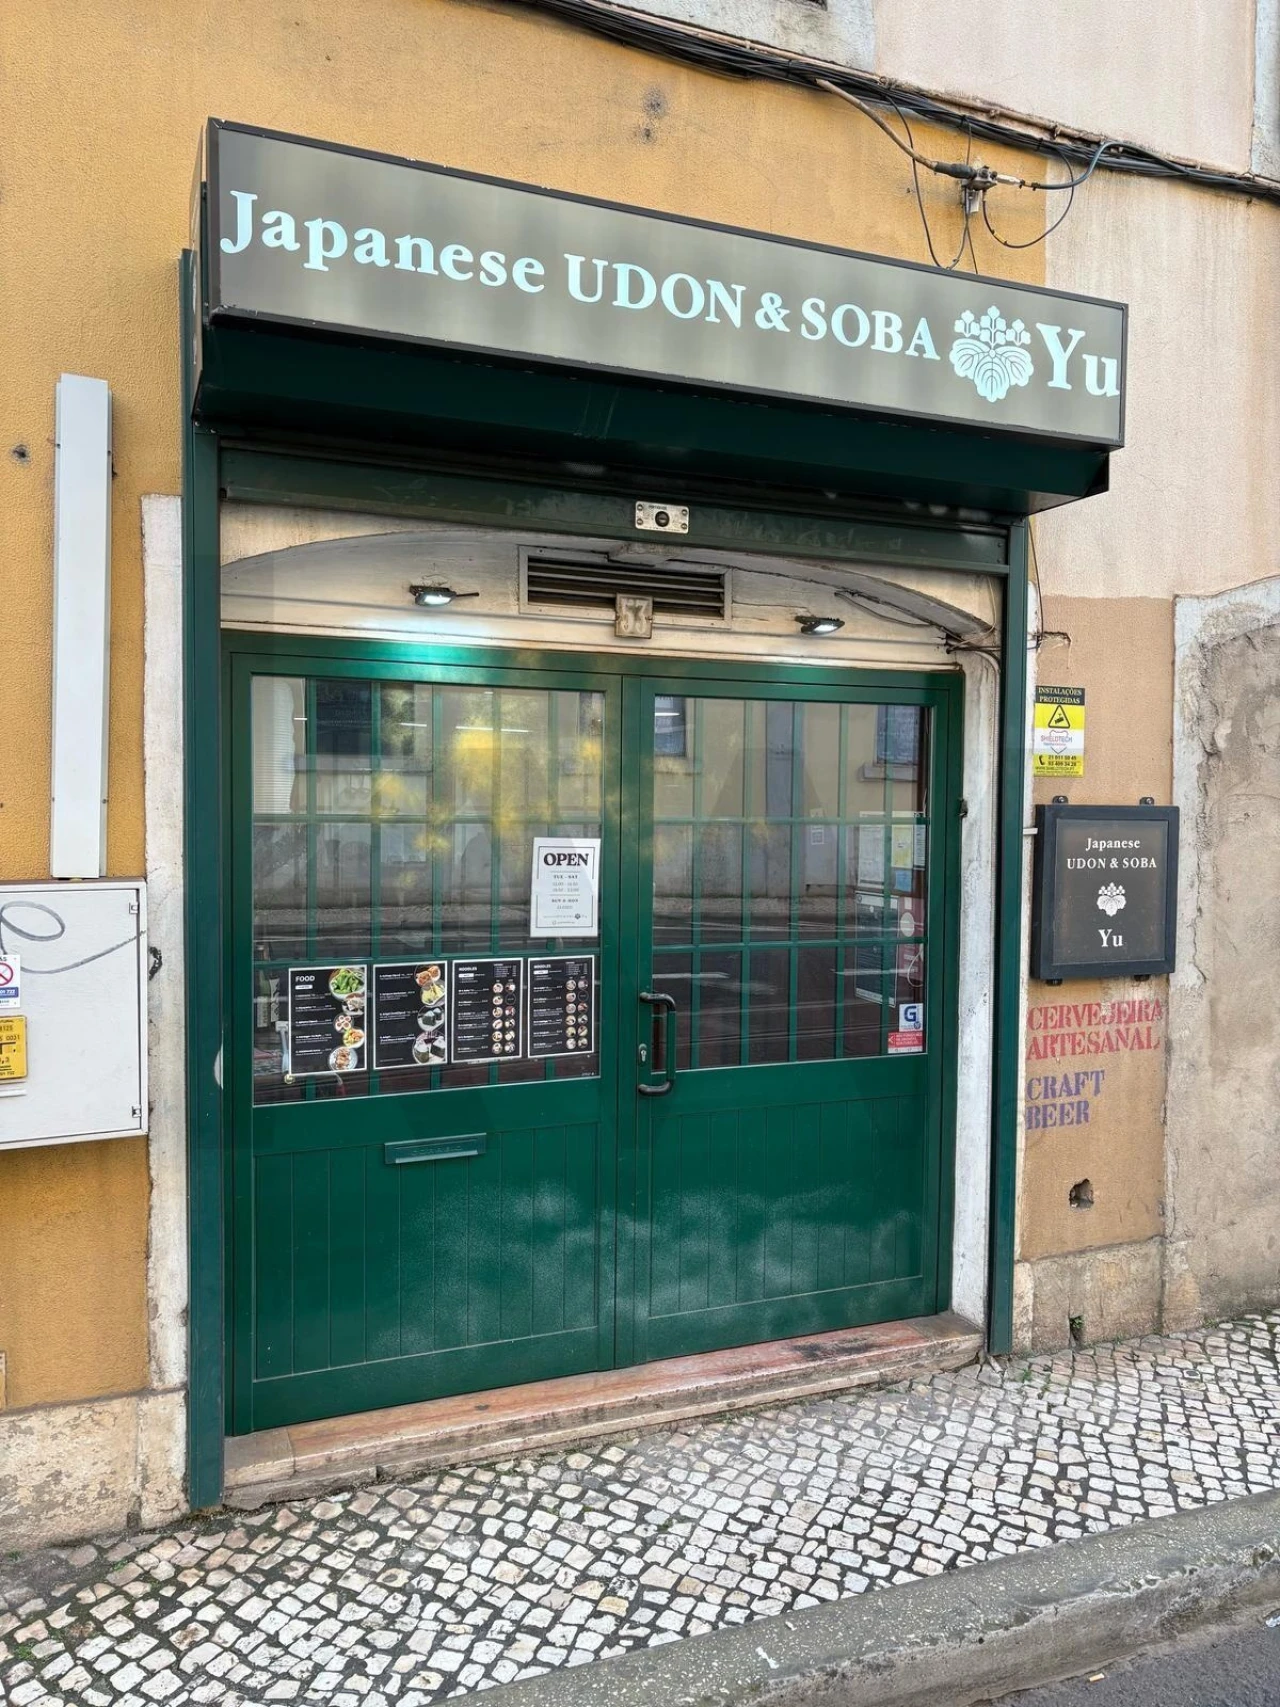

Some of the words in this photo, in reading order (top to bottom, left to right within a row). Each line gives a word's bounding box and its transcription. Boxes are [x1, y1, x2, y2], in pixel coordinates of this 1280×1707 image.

[219, 190, 545, 293] Japanese
[563, 253, 746, 328] UDON
[754, 291, 791, 333] &
[800, 297, 941, 360] SOBA
[1036, 322, 1120, 397] Yu
[1038, 686, 1082, 697] INSTALAÇÕES
[1039, 695, 1080, 704] PROTEGIDAS
[1086, 838, 1140, 851] Japanese
[543, 853, 589, 866] OPEN
[1067, 858, 1106, 869] UDON
[1109, 858, 1119, 869] &
[1122, 858, 1157, 869] SOBA
[1098, 929, 1124, 947] Yu
[904, 1005, 917, 1022] G
[1027, 998, 1164, 1031] CERVEJEIRA
[1026, 1026, 1160, 1060] ARTESANAL
[1026, 1069, 1105, 1101] CRAFT
[1025, 1100, 1090, 1130] BEER
